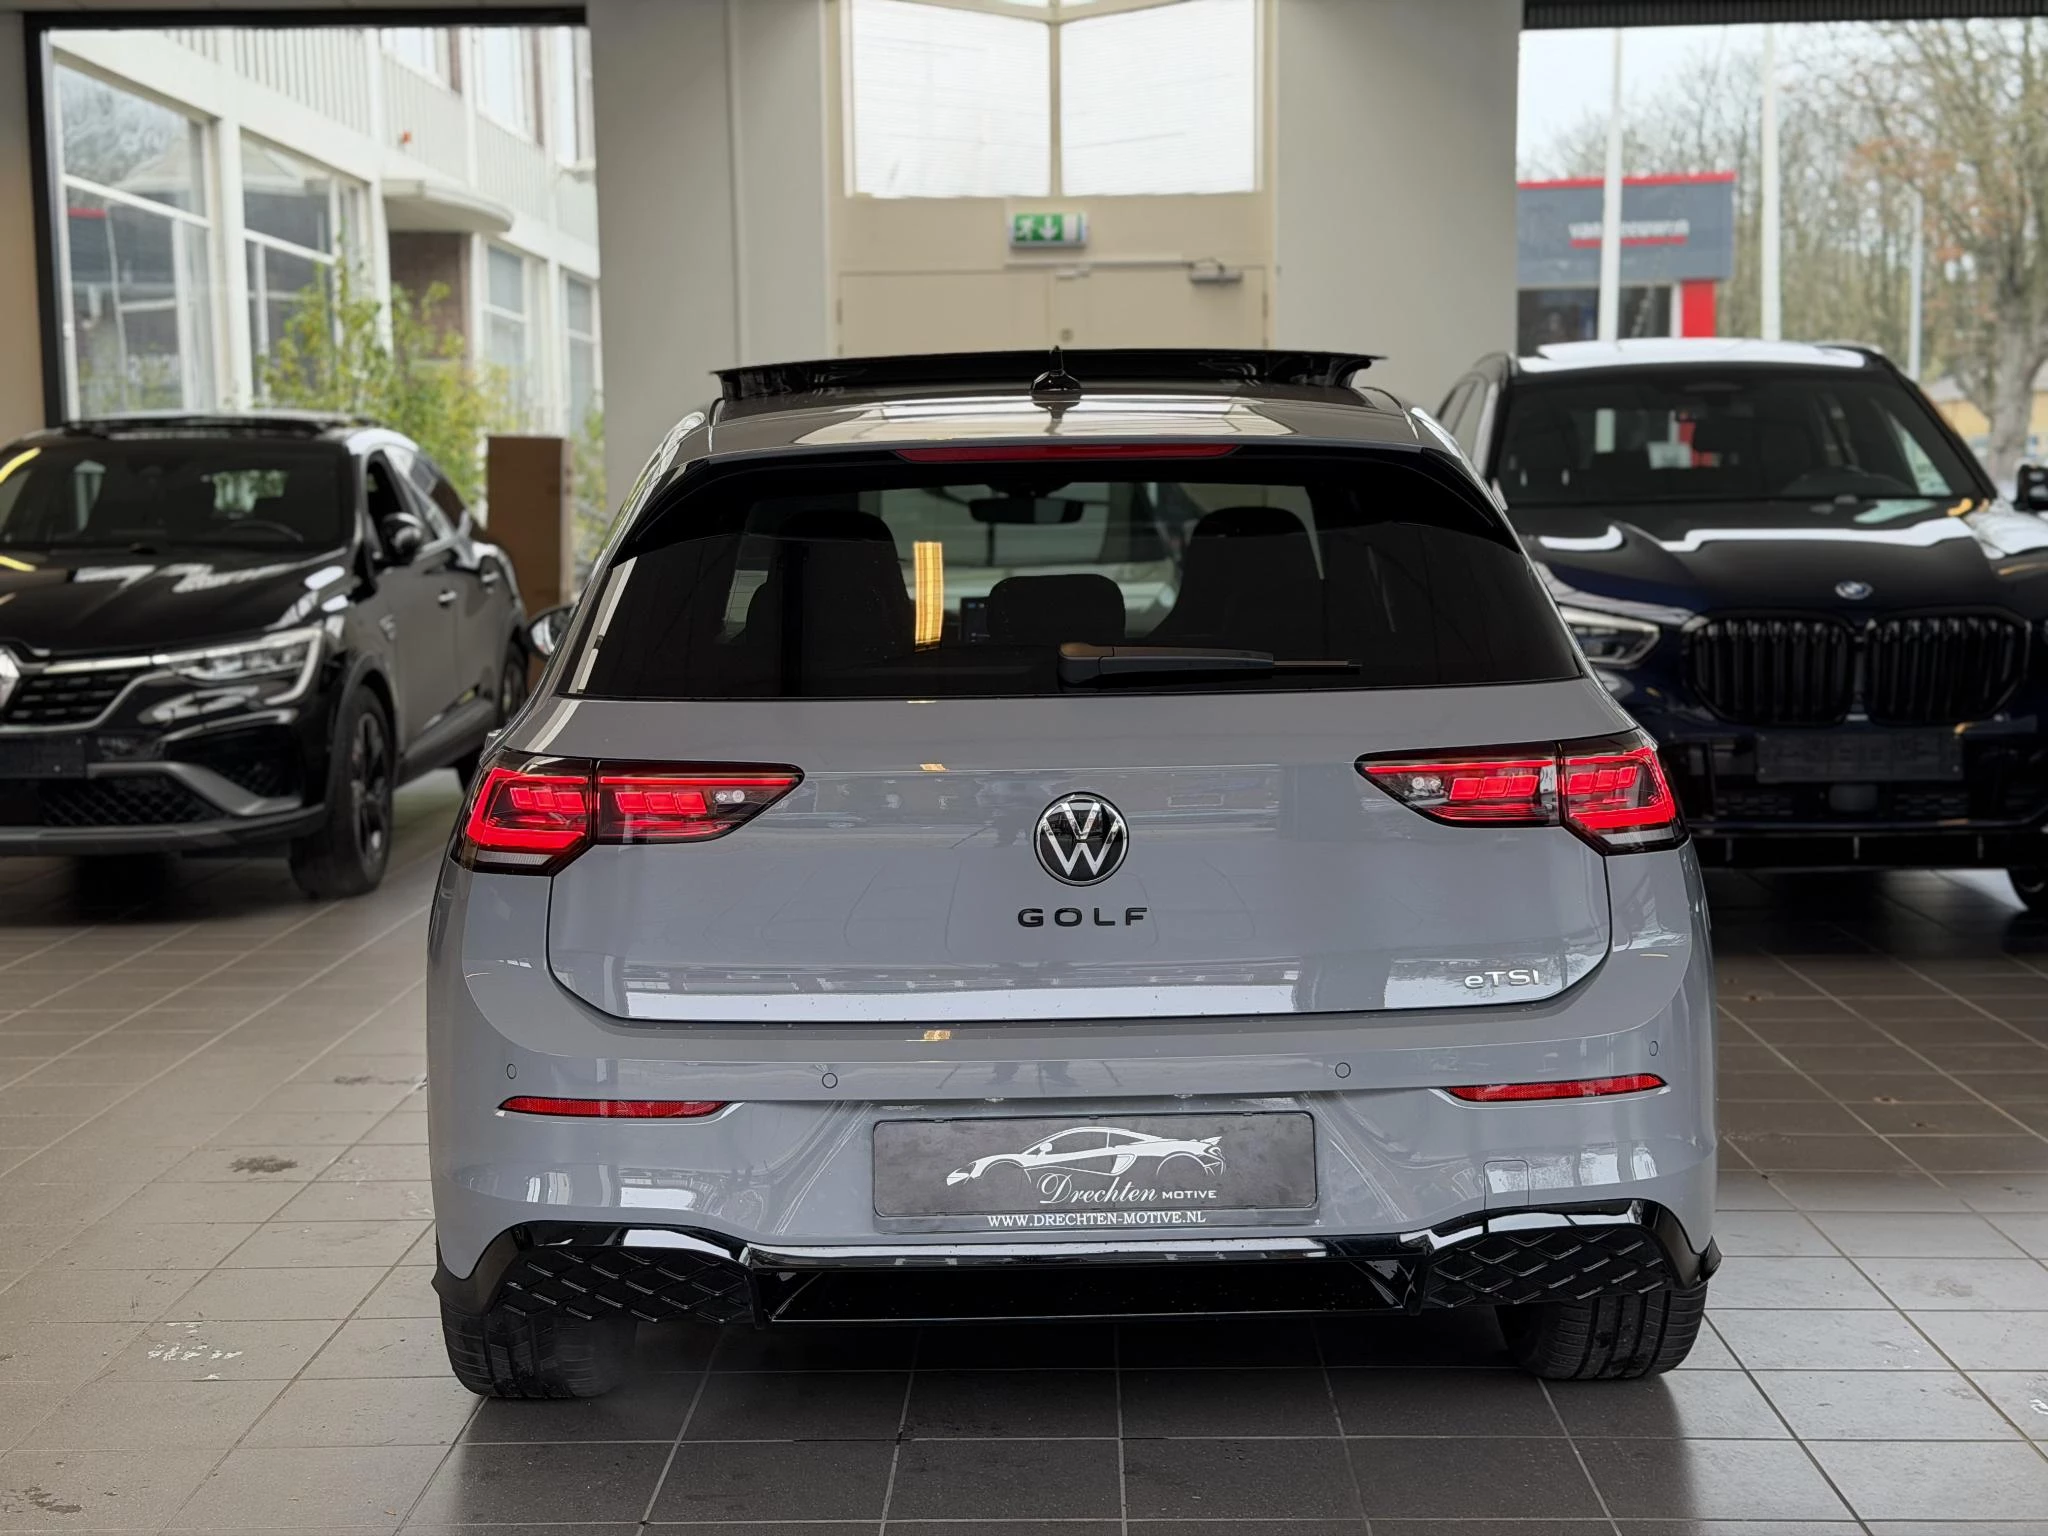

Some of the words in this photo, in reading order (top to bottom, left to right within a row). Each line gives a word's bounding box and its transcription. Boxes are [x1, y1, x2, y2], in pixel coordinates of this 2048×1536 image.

[1018, 907, 1148, 927] GOLF
[1464, 968, 1539, 989] eTSI
[1037, 1172, 1157, 1203] Drechten
[1162, 1189, 1217, 1199] MOTIVE
[987, 1210, 1206, 1227] WWW.DRECHTEN-MOTIVE.NL
